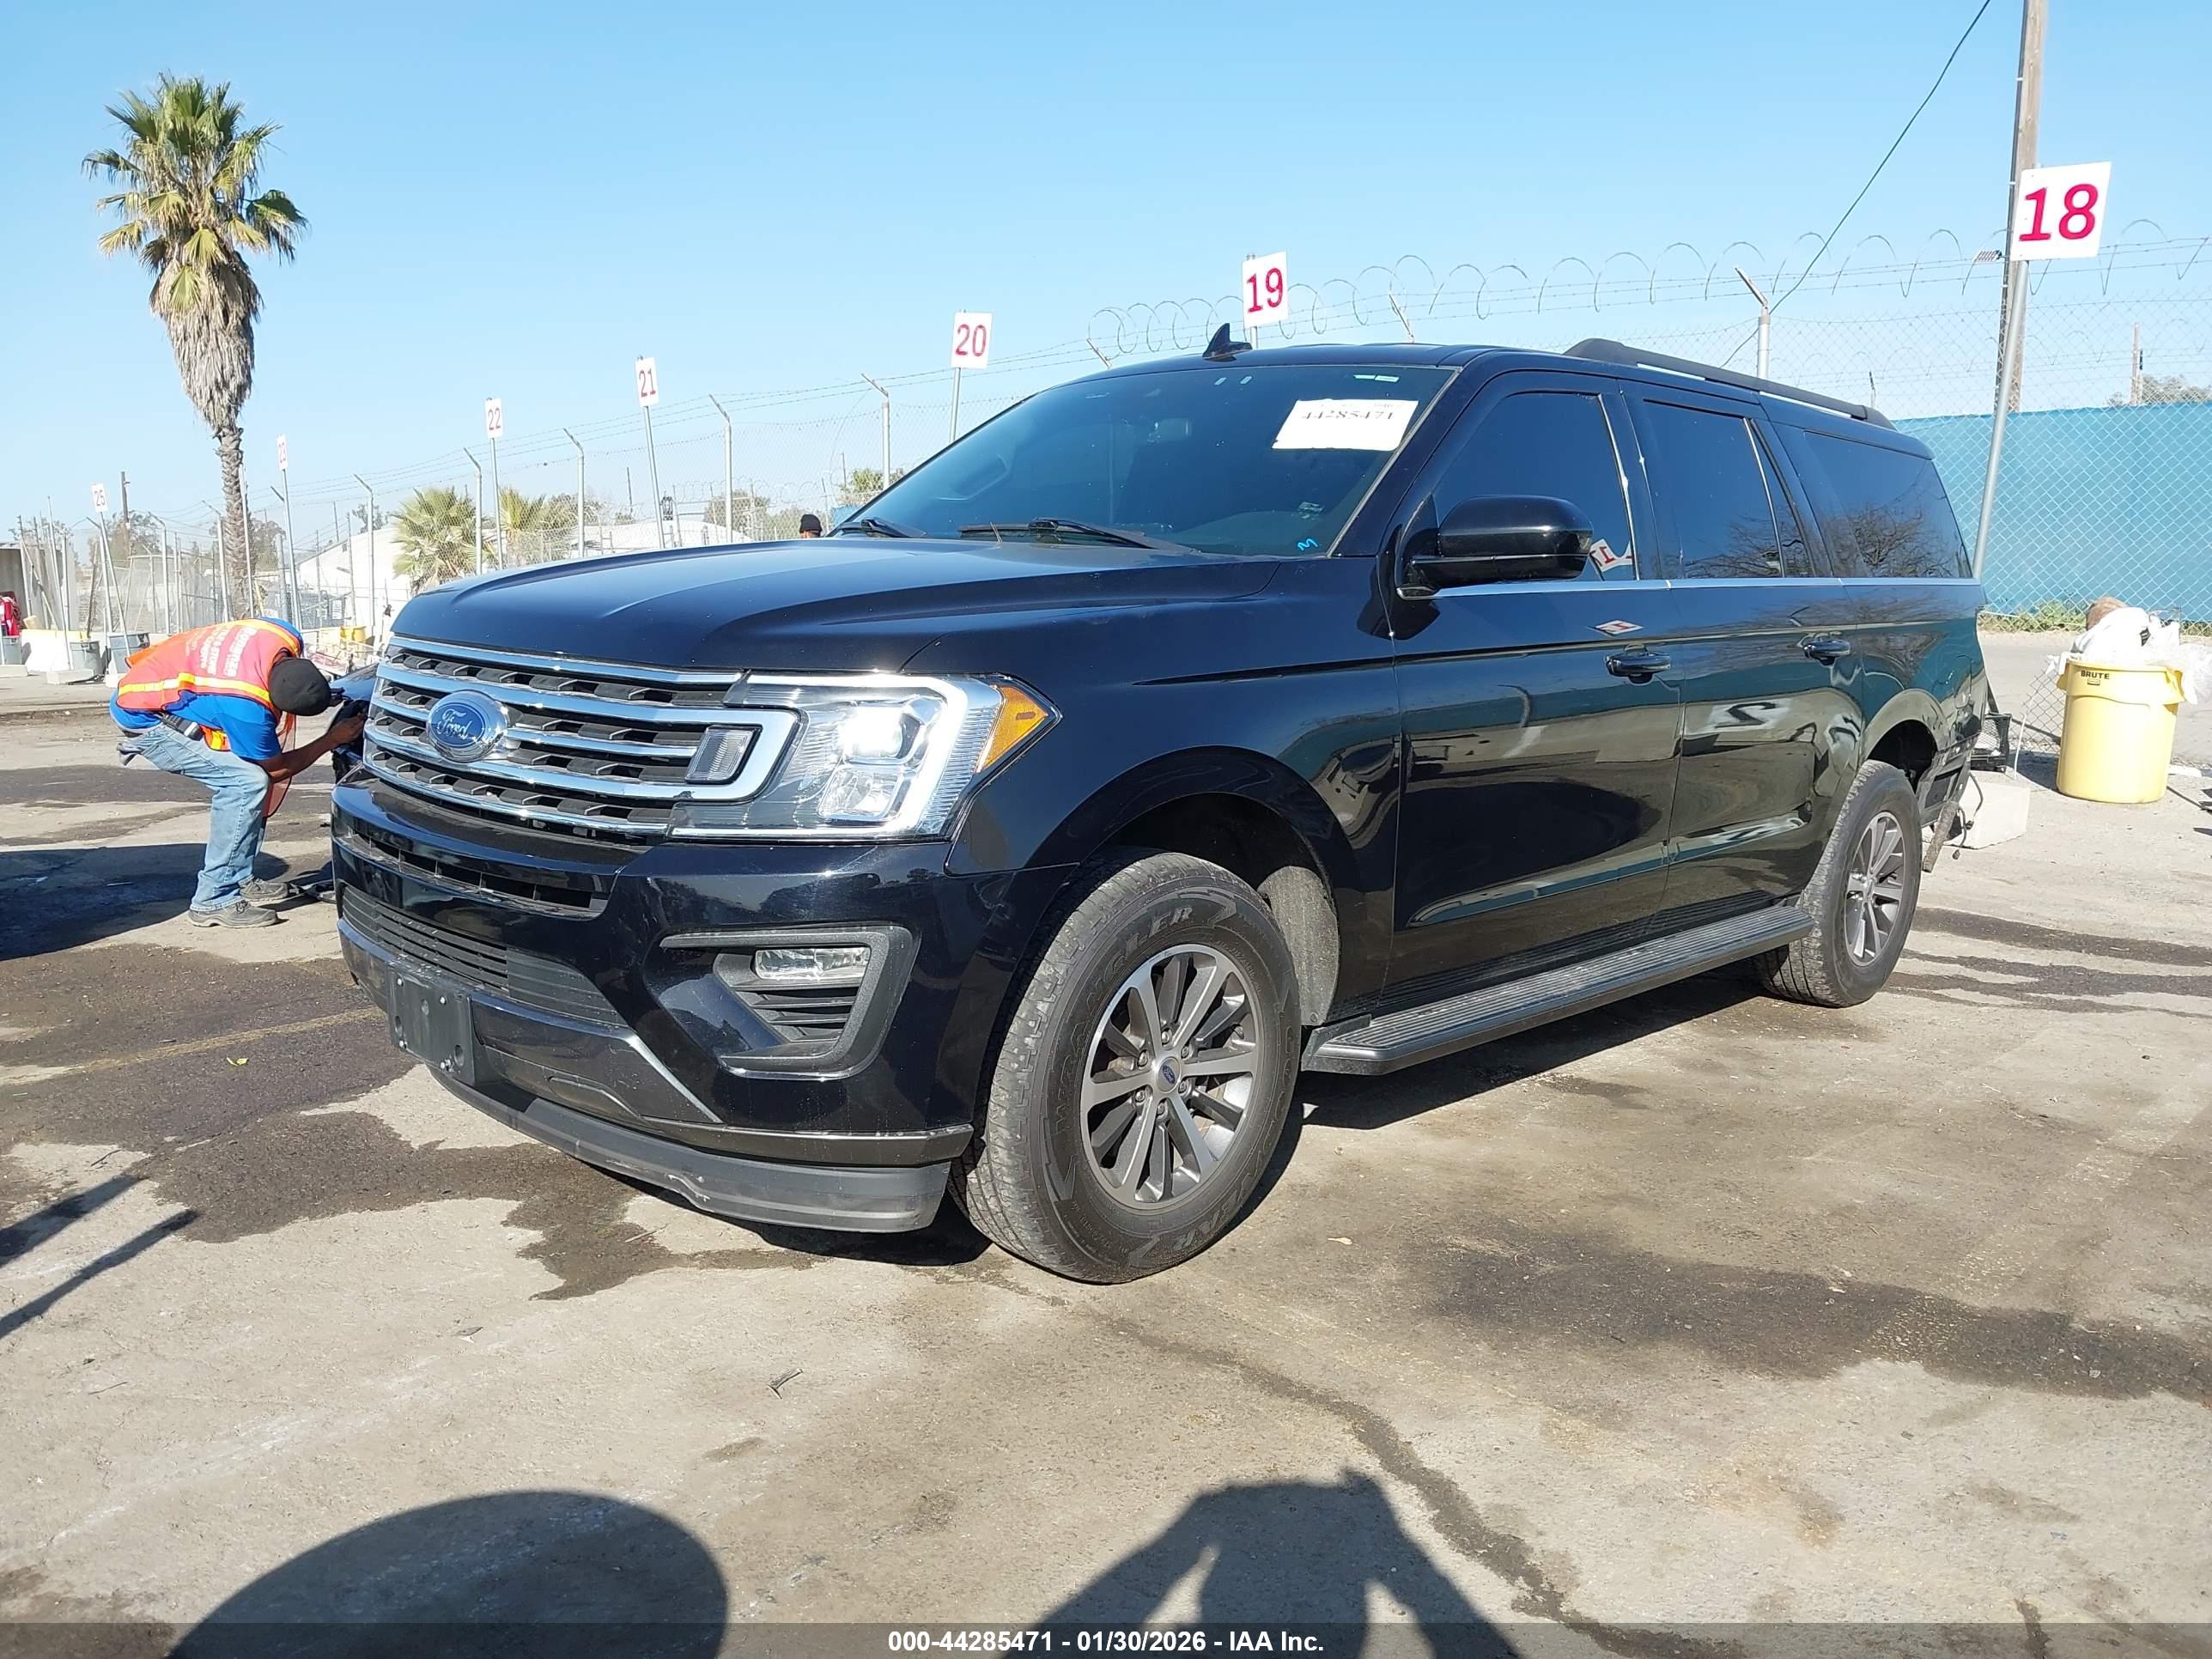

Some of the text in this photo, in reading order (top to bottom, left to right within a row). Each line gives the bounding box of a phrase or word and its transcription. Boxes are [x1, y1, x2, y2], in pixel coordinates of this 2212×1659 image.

[2019, 183, 2099, 242] 18
[1247, 267, 1284, 313] 19
[955, 324, 987, 356] 20
[638, 368, 657, 398] 21
[487, 407, 501, 430] 22
[1301, 410, 1395, 420] 44285471
[94, 489, 106, 507] 25
[2081, 670, 2110, 680] BRUTE
[435, 708, 474, 740] Ford
